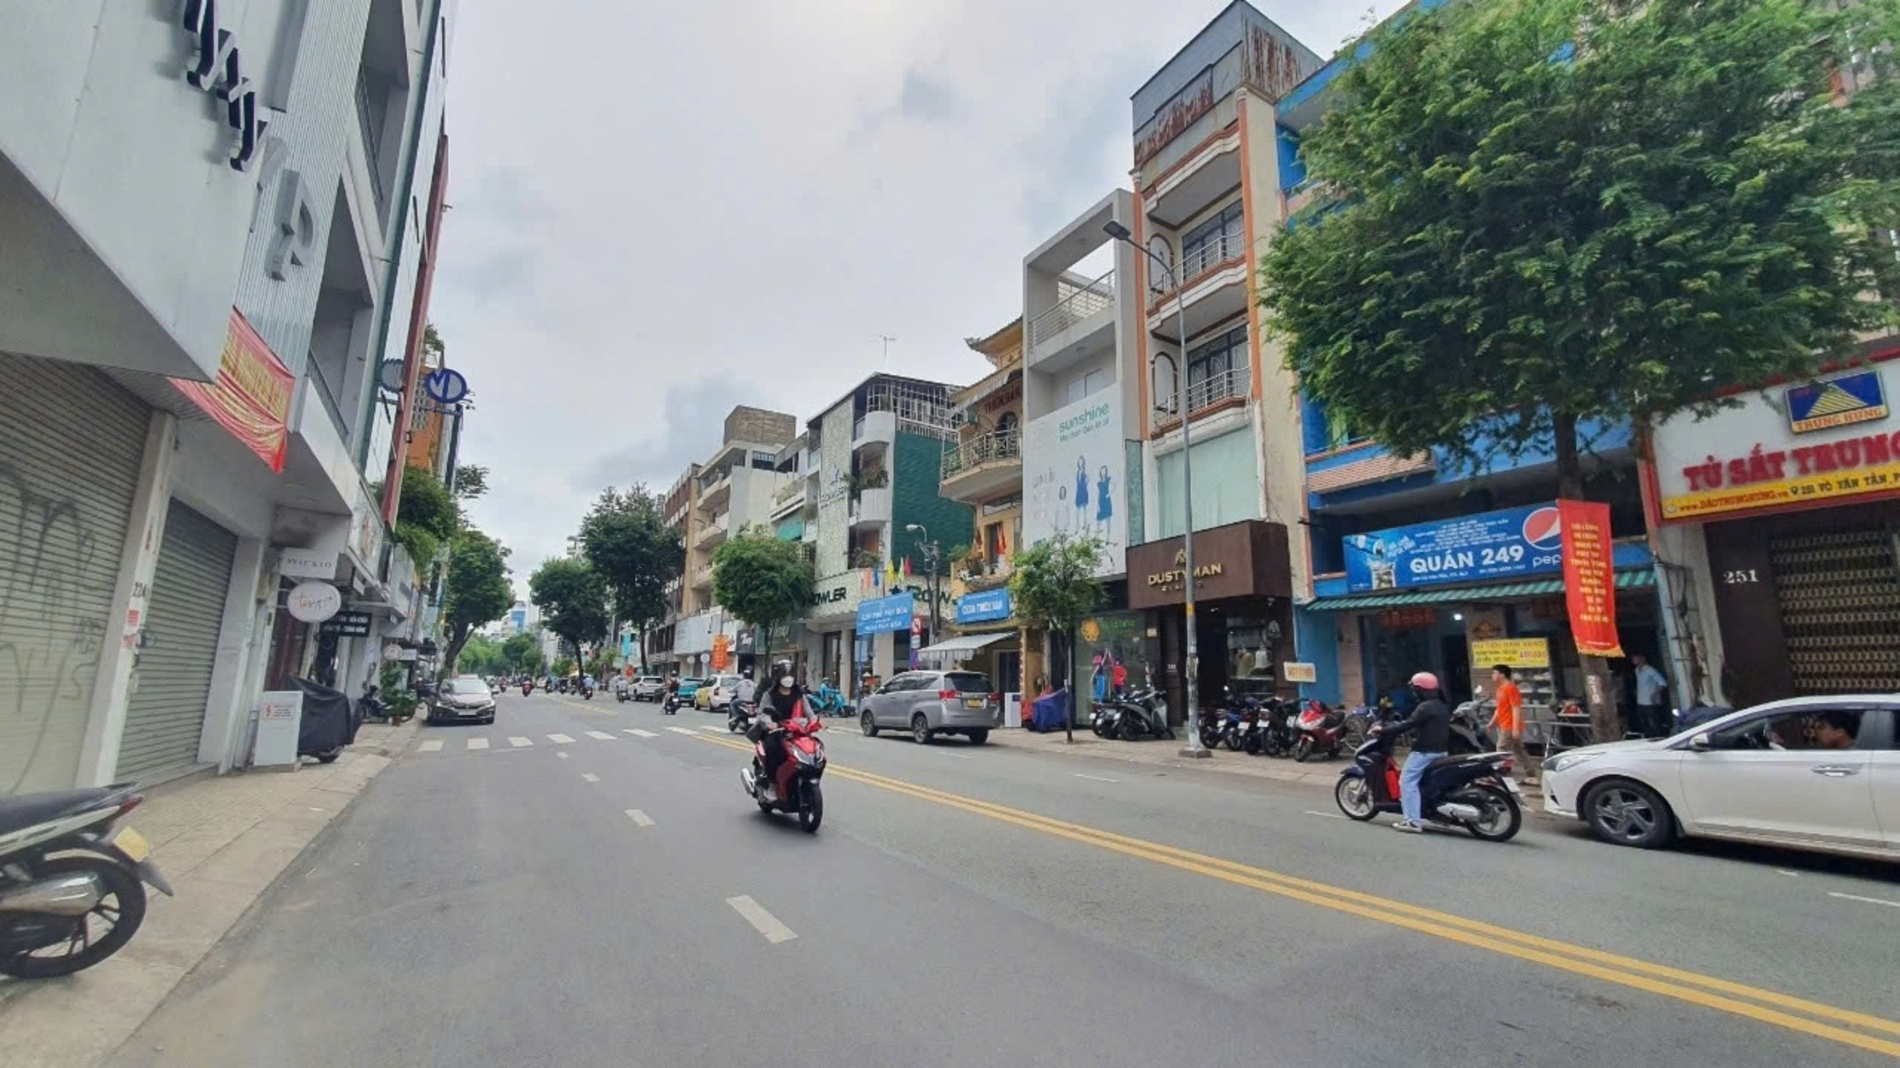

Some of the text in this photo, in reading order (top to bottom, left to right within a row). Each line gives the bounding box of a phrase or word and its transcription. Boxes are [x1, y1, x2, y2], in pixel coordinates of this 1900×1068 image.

[1059, 403, 1109, 432] sunshine
[1796, 412, 1841, 431] TRUNG
[1683, 455, 1723, 491] TỦ
[1729, 443, 1786, 485] SẮT
[1409, 548, 1475, 574] QUÁN
[1481, 544, 1524, 566] 249
[1532, 554, 1562, 568] pep
[1723, 569, 1759, 584] 251
[810, 586, 847, 607] OWLER
